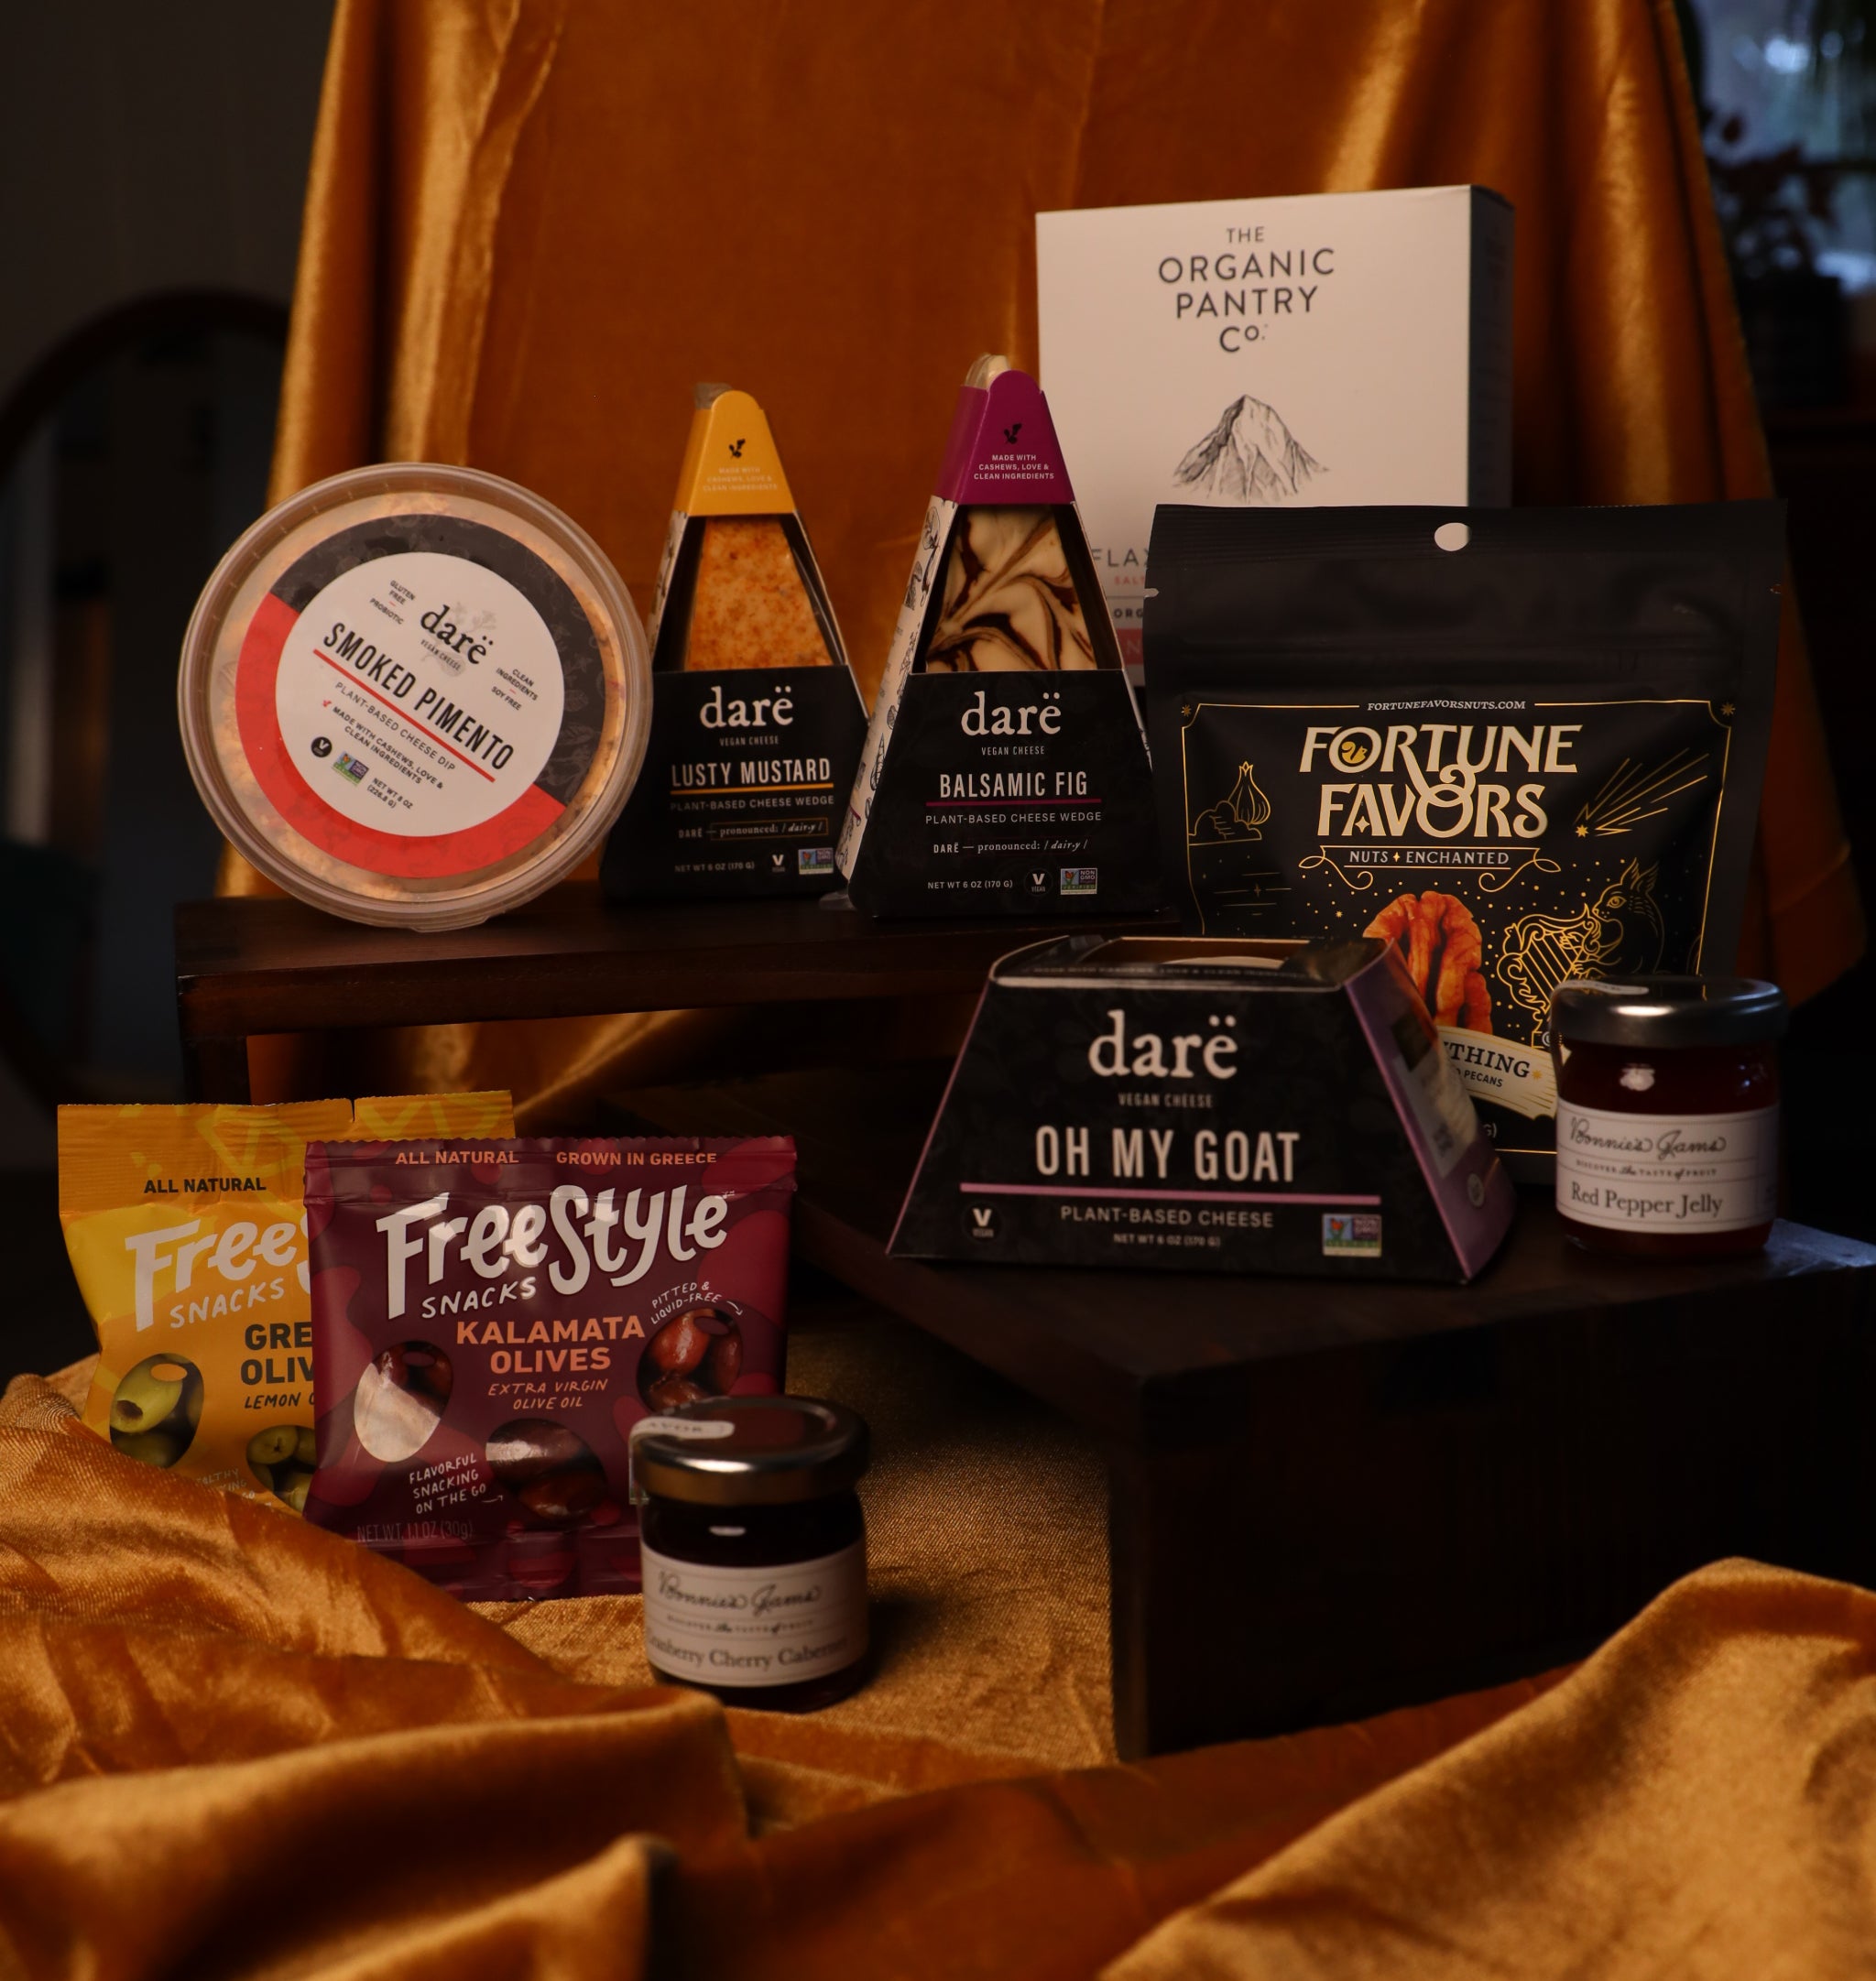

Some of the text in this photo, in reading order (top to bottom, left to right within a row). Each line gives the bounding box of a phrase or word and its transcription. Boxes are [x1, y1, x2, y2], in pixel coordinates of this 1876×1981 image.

[1227, 226, 1265, 244] THE
[1159, 248, 1335, 283] ORGANIC
[1176, 286, 1317, 319] PANTRY
[389, 590, 407, 604] FREE
[390, 580, 415, 601] GLUTEN
[370, 598, 404, 625] PROBIOTIC
[496, 668, 538, 702] INGREDIENTS
[511, 669, 534, 687] CLEAN
[323, 622, 514, 770] SMOKED PIMENTO
[491, 686, 521, 711] SOY FREE
[699, 686, 794, 728] darë
[1367, 699, 1526, 711] FORTUNEFAVORSNUTS.COM
[334, 681, 455, 771] PLANT-BASED CHEESE DIP
[961, 691, 1062, 736] darë
[333, 705, 355, 726] MADE
[355, 722, 376, 740] WITH
[376, 738, 414, 769] CASHEWS,
[416, 767, 435, 785] LOVE
[720, 735, 779, 746] VEGAN CHEESE
[981, 746, 1045, 756] VEGAN CHEESE
[1299, 724, 1583, 777] FORTUNE
[344, 726, 371, 746] CLEAN
[370, 745, 422, 784] INGREDIENTS
[671, 757, 831, 788] LUSTY MUSTARD
[940, 770, 1087, 799] BALSAMIC FIG
[373, 778, 387, 790] NET
[387, 789, 398, 798] WT
[403, 800, 413, 809] OZ
[670, 795, 834, 812] PLANT-BASED CHEESE WEDGE
[925, 811, 1102, 825] PLANT-BASED CHEESE WEDGE
[1317, 783, 1548, 838] FAVORS
[720, 824, 778, 839] pronounced:
[977, 840, 1041, 854] pronounced:
[1349, 850, 1509, 865] NUTS ENCHANTED
[675, 864, 693, 873] NET
[693, 864, 706, 872] WT
[715, 863, 726, 871] OZ
[947, 881, 961, 889] WT
[970, 880, 982, 888] OZ
[985, 880, 1000, 889] (170
[1003, 879, 1013, 888] G)
[1088, 1009, 1238, 1080] darë
[1443, 1040, 1530, 1078] THING
[1464, 1070, 1503, 1088] PECANS
[1118, 1094, 1214, 1109] VEGAN CHEESE
[1570, 1117, 1726, 1159] Bonnie's Jams
[396, 1150, 519, 1166] ALL NATURAL
[556, 1151, 717, 1166] GROWN IN GREECE
[1035, 1125, 1301, 1183] OH MY GOAT
[144, 1177, 266, 1194] ALL NATURAL
[1572, 1181, 1723, 1218] Red Pepper Jelly
[1061, 1205, 1273, 1229] PLANT-BASED CHEESE
[1113, 1233, 1136, 1244] NET
[1138, 1234, 1154, 1245] WT
[1157, 1235, 1164, 1245] 6
[1166, 1235, 1181, 1246] OZ
[169, 1278, 285, 1329] SNACKS
[421, 1277, 537, 1319] SNACKS
[650, 1292, 722, 1324] LIQUID-FREE
[652, 1281, 710, 1309] PITTED &
[457, 1314, 645, 1345] KALAMATA
[490, 1347, 611, 1374] OLIVES
[245, 1391, 300, 1410] LEMON
[487, 1377, 608, 1397] EXTRA VIRGIN
[513, 1396, 584, 1410] OLIVE OIL
[409, 1453, 477, 1485] FLAVORFUL
[412, 1469, 479, 1499] SNACKING
[415, 1483, 486, 1515] ON THE GO
[709, 1649, 773, 1671] Cherry
